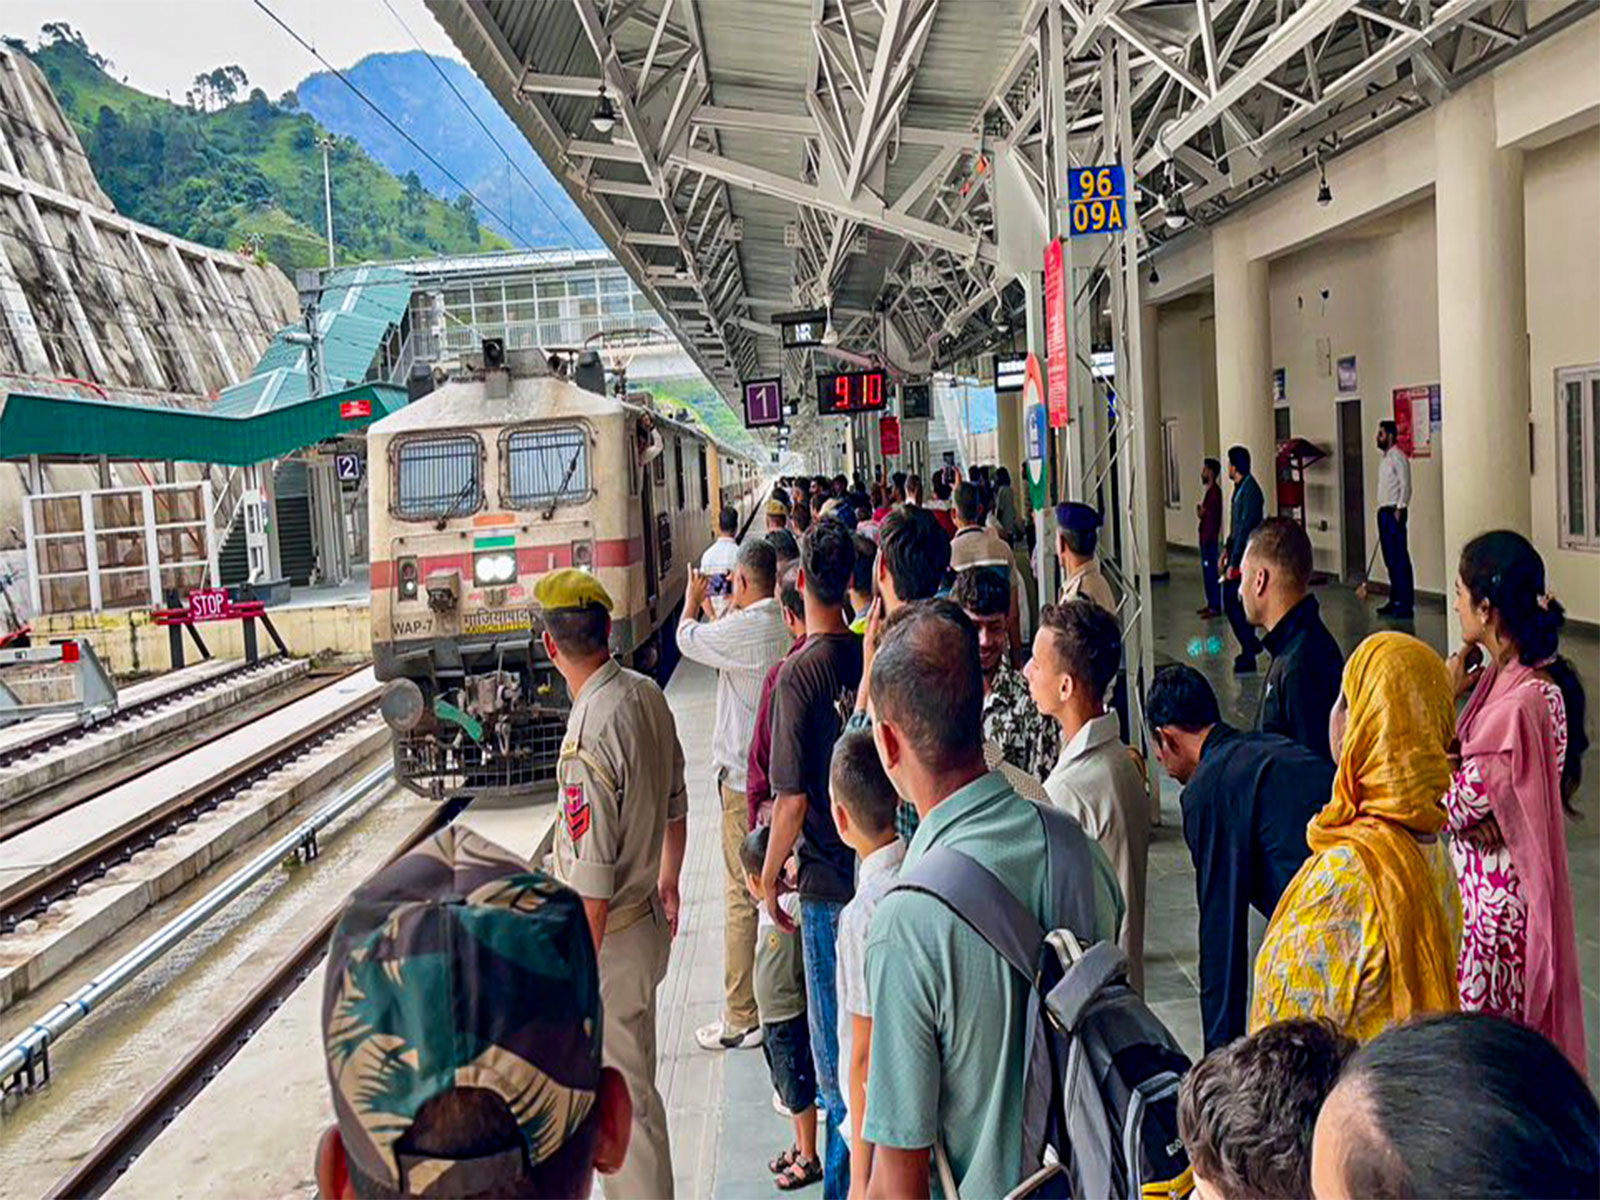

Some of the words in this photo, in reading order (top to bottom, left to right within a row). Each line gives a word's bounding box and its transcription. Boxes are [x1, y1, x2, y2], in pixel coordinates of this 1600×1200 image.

[1080, 169, 1112, 200] 96
[1074, 200, 1122, 231] 09A
[756, 387, 768, 417] 1
[342, 457, 354, 476] 2
[192, 593, 224, 616] STOP
[391, 619, 432, 635] WAP-7
